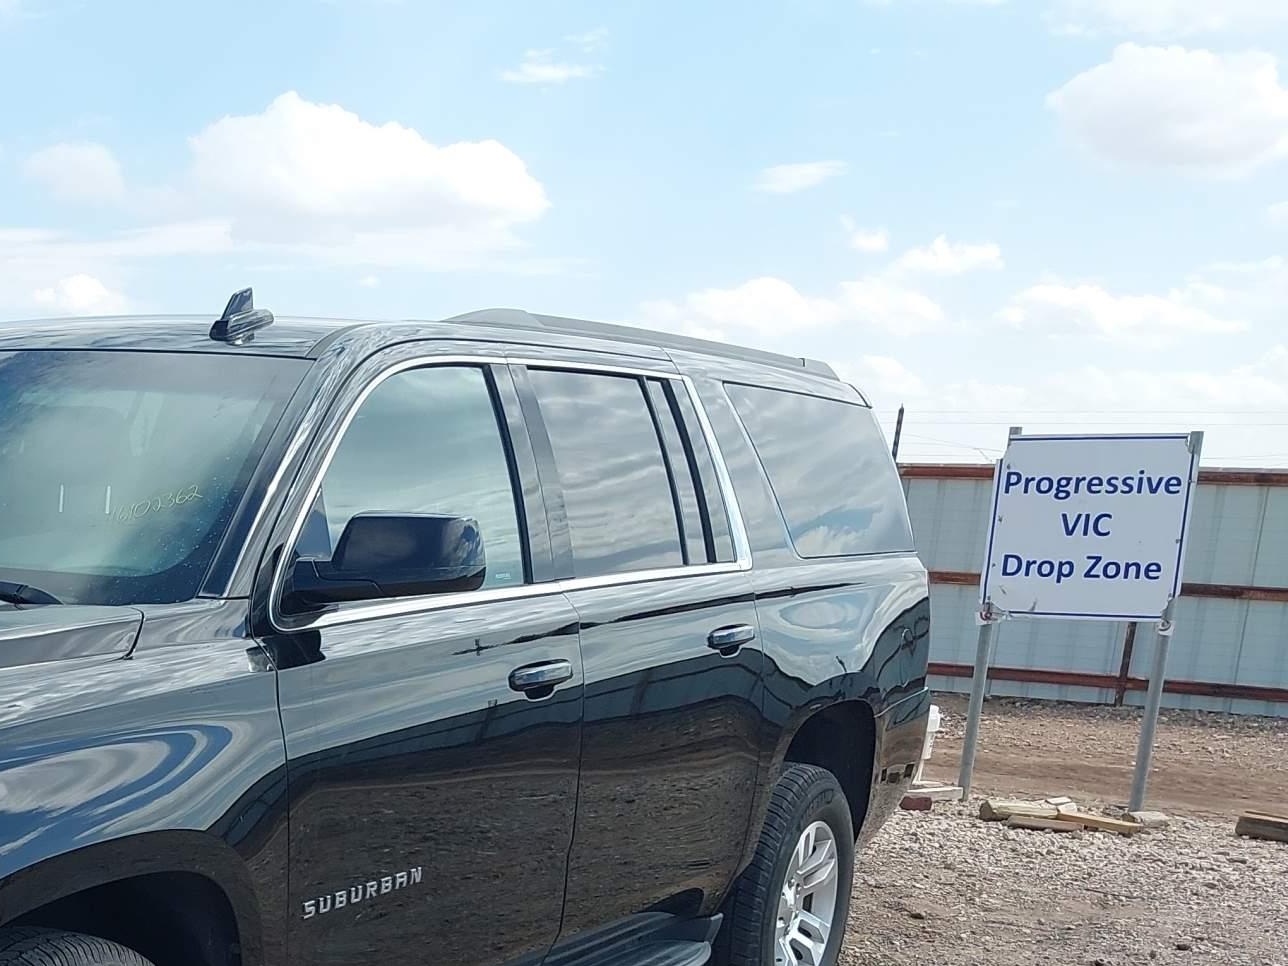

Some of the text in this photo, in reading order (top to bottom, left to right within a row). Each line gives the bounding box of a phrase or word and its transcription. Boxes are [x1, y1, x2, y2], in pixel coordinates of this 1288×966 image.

[1004, 470, 1183, 500] Progressive
[1062, 513, 1113, 537] VIC
[1001, 554, 1163, 584] Drop Zone
[303, 867, 422, 919] SUBURBAN
